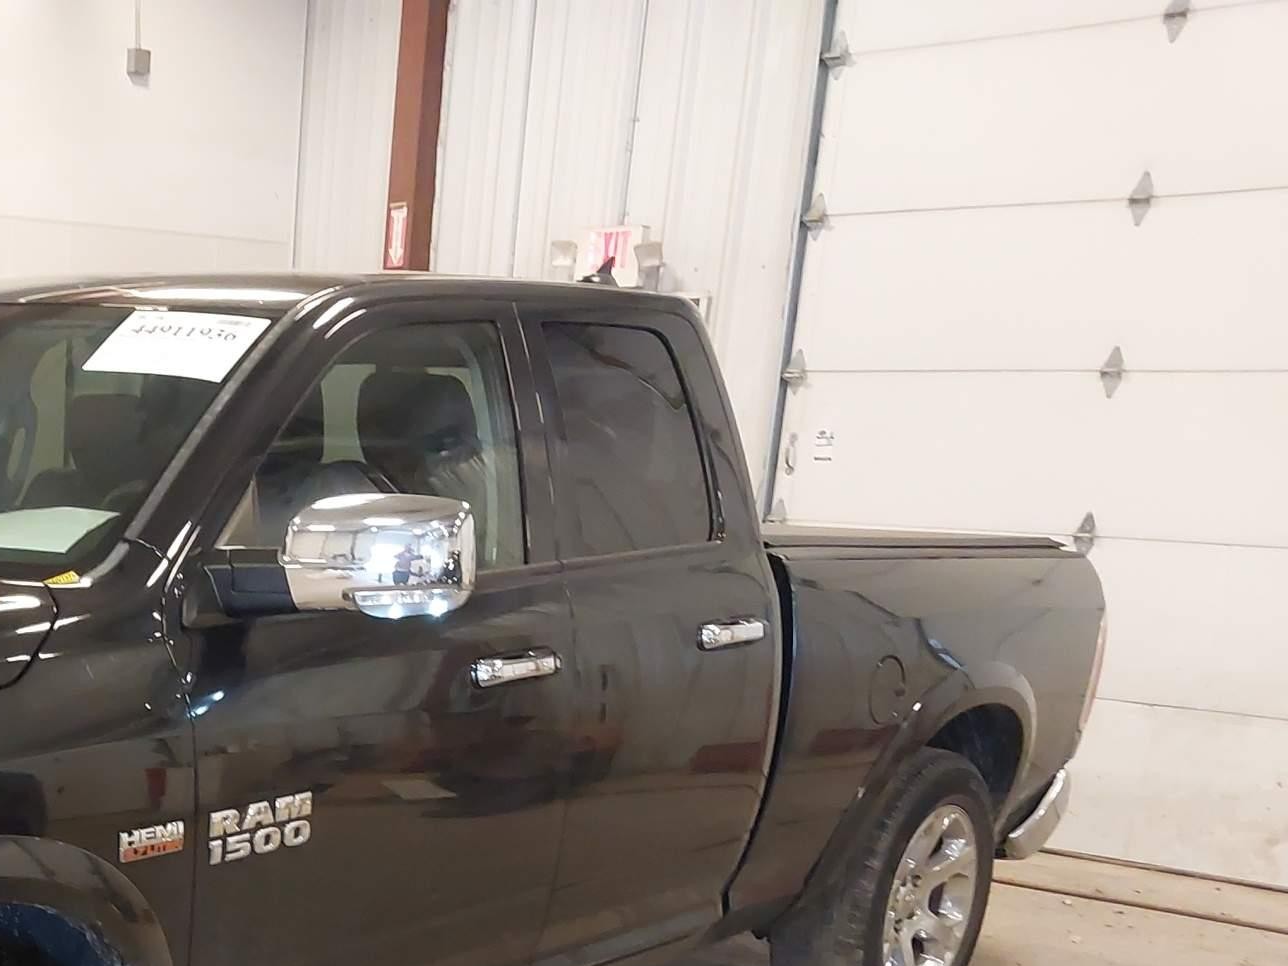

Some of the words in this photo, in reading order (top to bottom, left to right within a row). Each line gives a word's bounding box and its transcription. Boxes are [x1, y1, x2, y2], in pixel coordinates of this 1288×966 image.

[119, 820, 185, 849] HEMI
[209, 791, 312, 838] RAM
[208, 820, 311, 866] 1500
